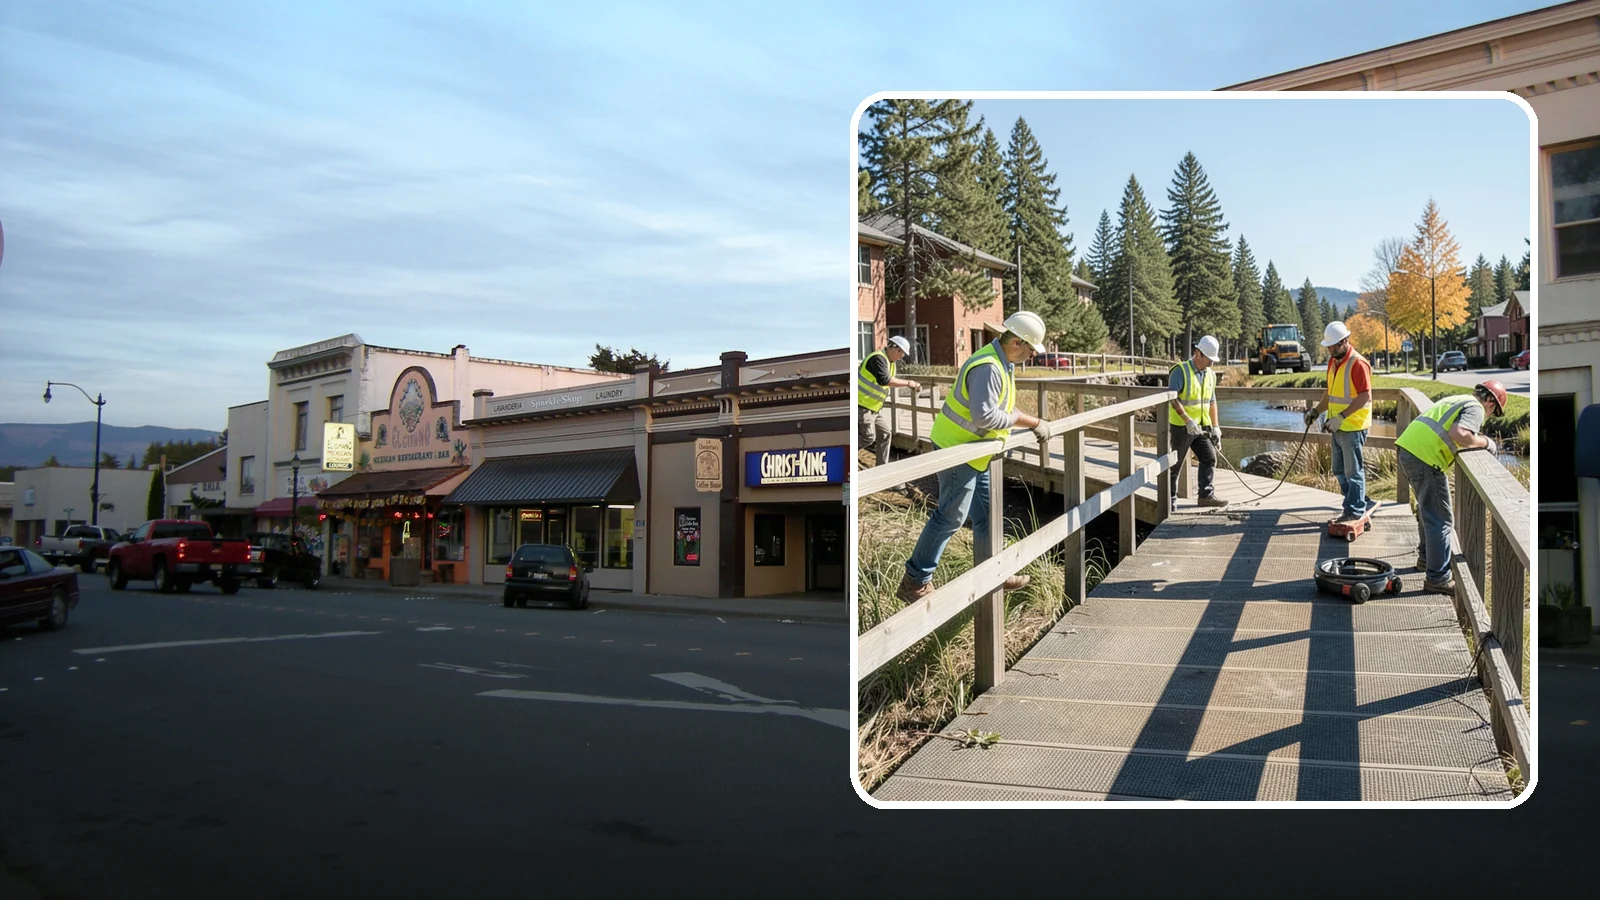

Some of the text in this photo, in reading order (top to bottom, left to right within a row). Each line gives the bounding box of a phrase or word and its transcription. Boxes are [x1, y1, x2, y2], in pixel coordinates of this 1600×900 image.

[530, 394, 582, 409] Sparkle Shop
[595, 389, 624, 400] LAUNDRY
[493, 402, 523, 412] LAVANDERIA
[391, 425, 401, 449] EL
[373, 450, 450, 464] MEXICAN RESTAURANT BAR
[760, 450, 827, 478] CHRIST KING
[696, 481, 722, 489] Coffee House
